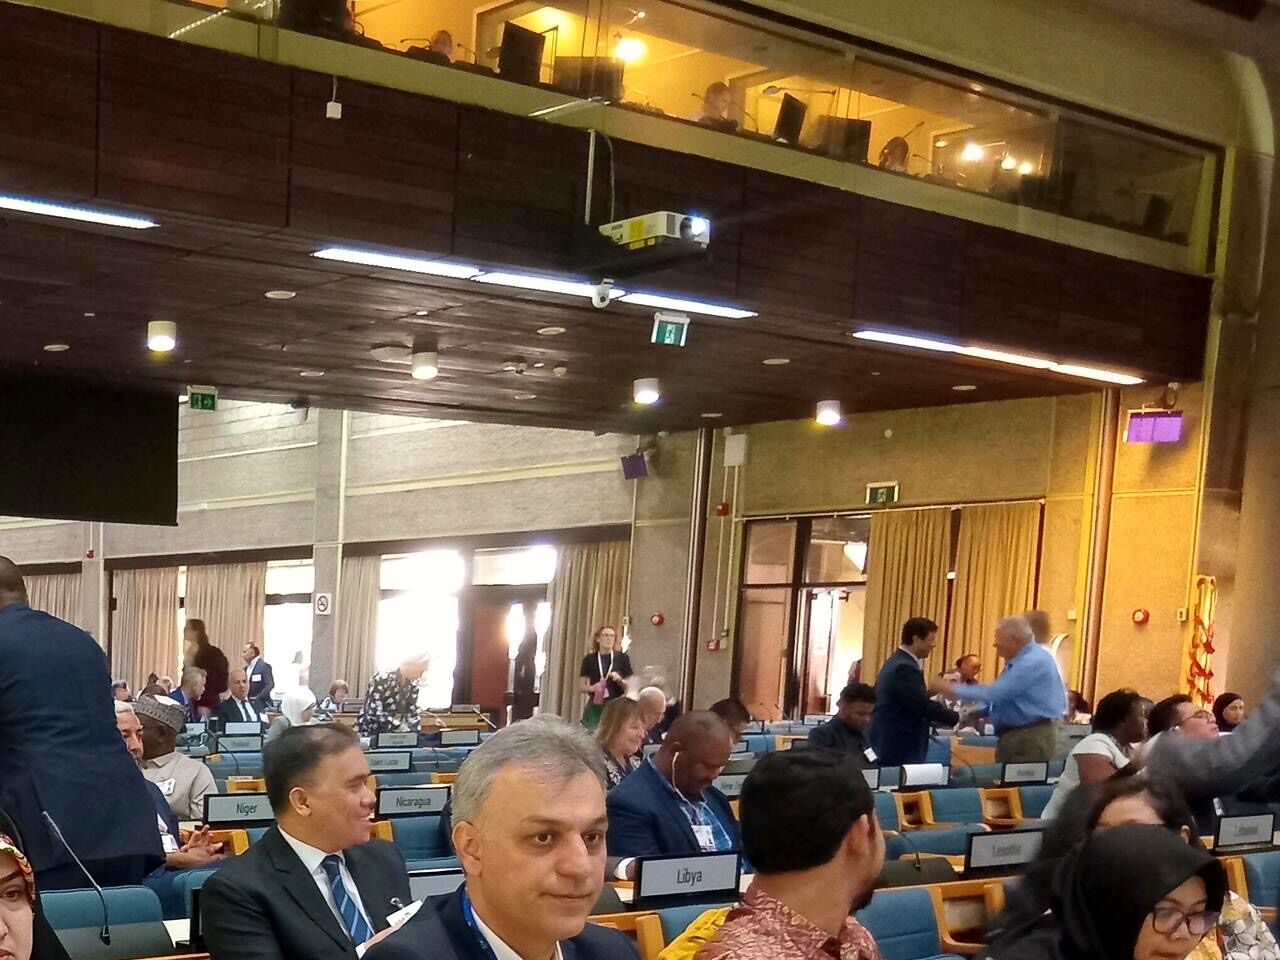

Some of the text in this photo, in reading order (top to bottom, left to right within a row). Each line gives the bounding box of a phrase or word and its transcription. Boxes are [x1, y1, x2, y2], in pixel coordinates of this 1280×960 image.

[396, 796, 432, 809] Nicaragua
[236, 803, 258, 816] Niger
[676, 867, 702, 887] Libya
